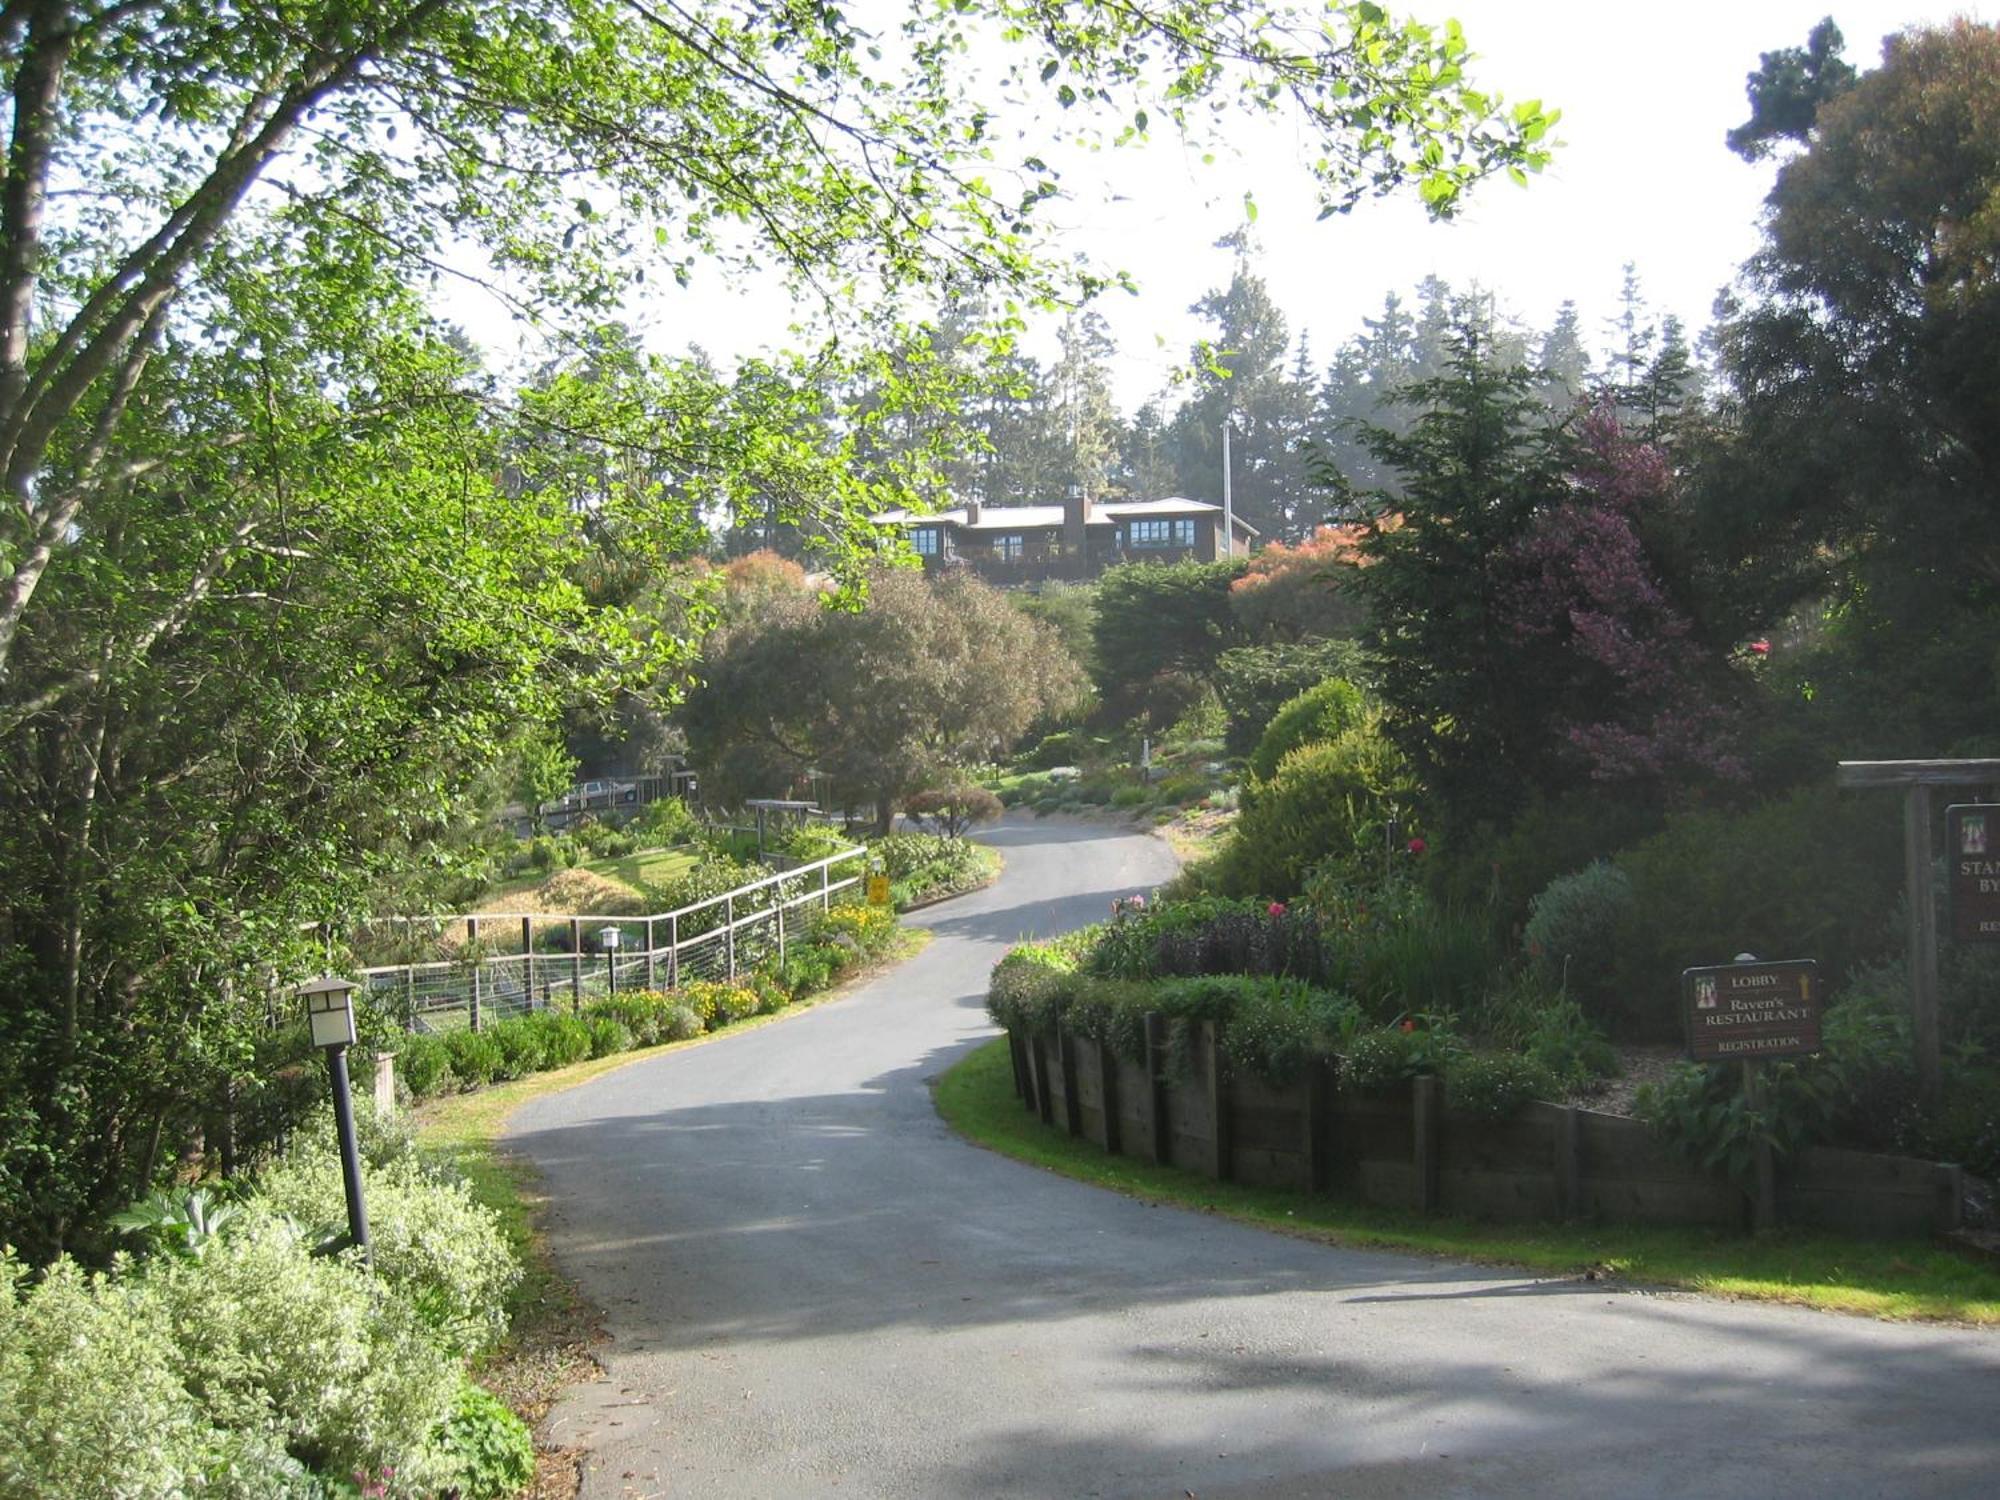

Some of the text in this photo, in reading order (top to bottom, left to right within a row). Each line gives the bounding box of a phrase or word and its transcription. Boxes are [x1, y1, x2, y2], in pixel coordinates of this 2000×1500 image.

[1731, 974, 1778, 988] LOBBY
[1730, 996, 1784, 1011] Raven's
[1706, 1007, 1808, 1025] RESTAURANT
[1718, 1036, 1800, 1052] REGISTRATION
